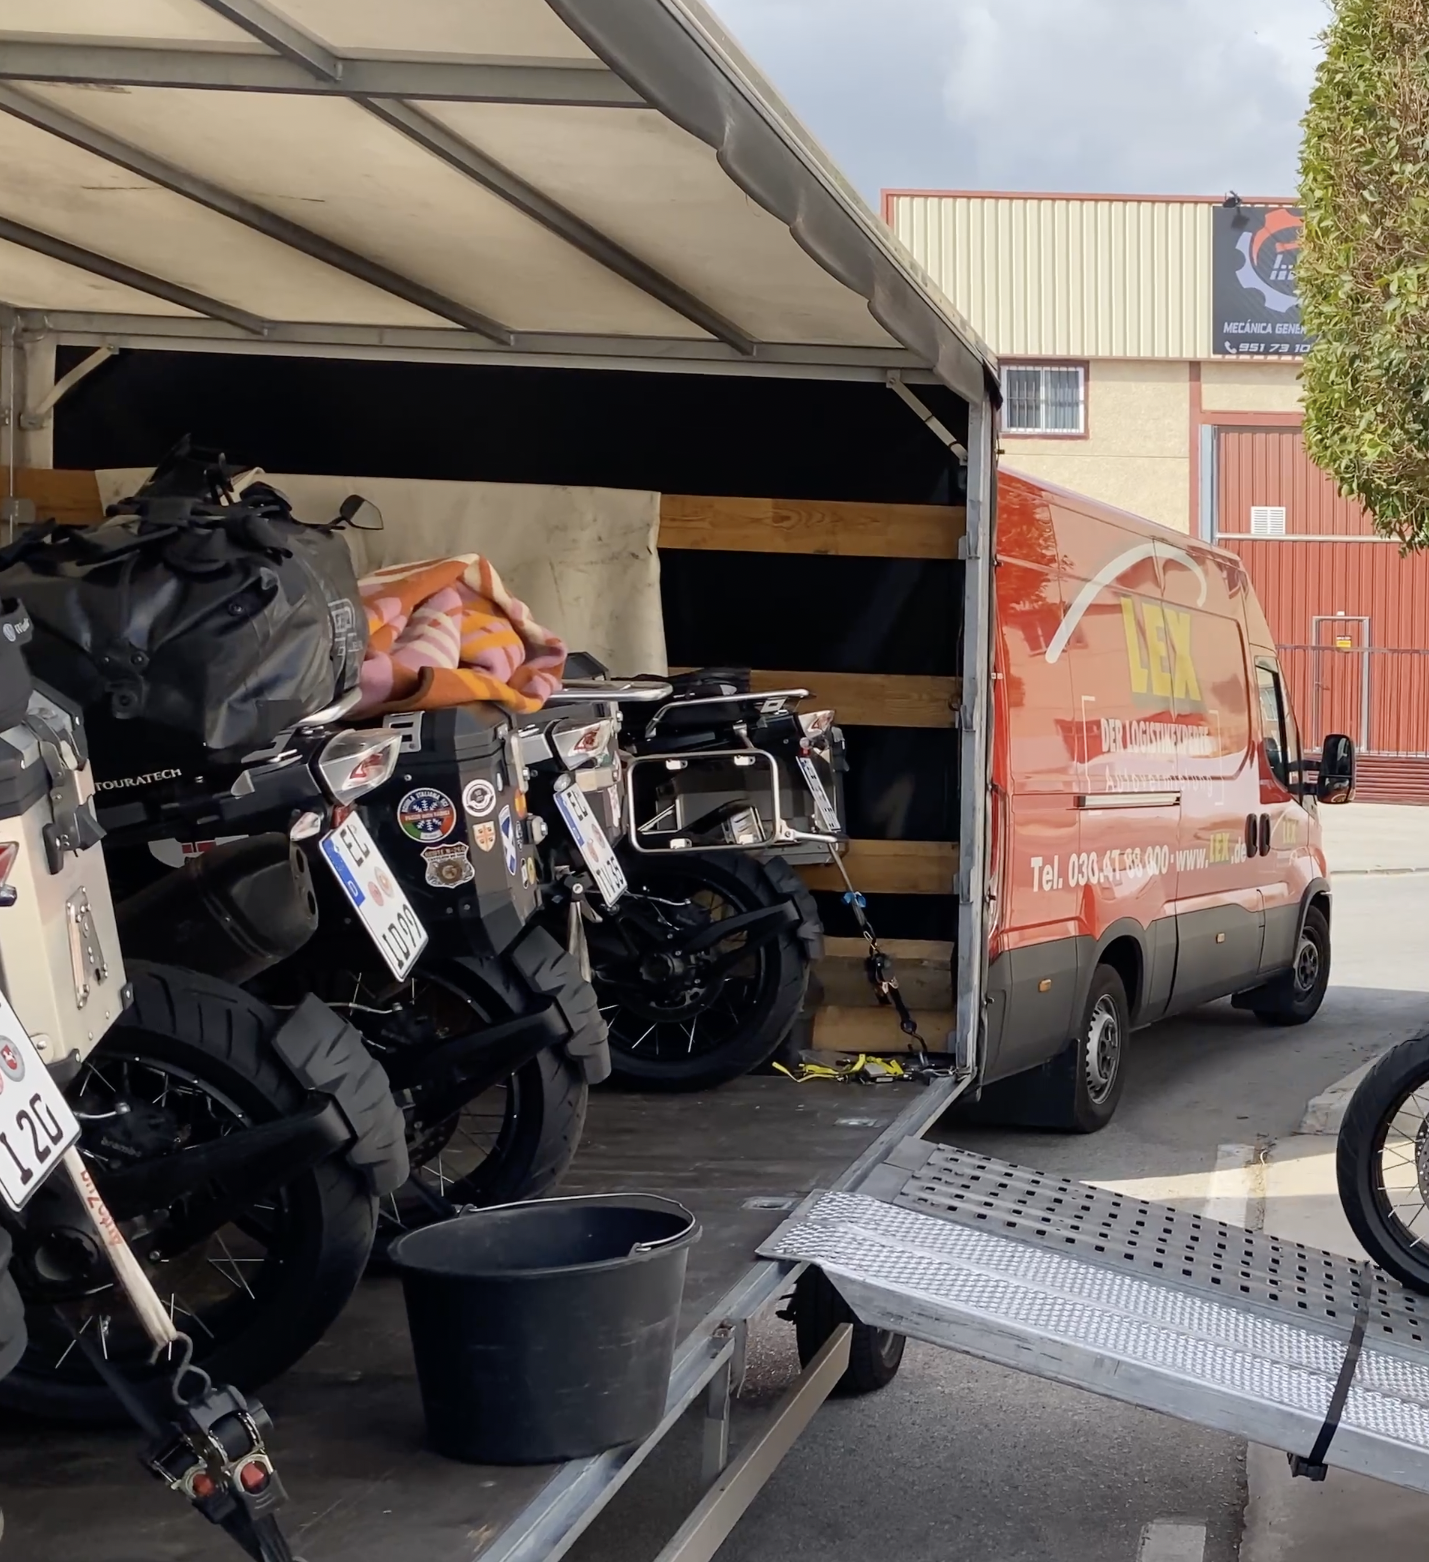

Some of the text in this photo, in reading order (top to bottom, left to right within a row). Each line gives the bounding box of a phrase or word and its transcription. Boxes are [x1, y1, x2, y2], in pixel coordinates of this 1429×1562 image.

[1223, 319, 1273, 335] MECÁNICA
[1239, 343, 1265, 353] 951
[1269, 343, 1290, 353] 73
[1120, 596, 1202, 702] LEX
[1100, 717, 1123, 753] DER
[95, 767, 183, 792] TOURATECH
[566, 789, 589, 822] EL
[339, 823, 372, 868] EL
[1030, 854, 1064, 893] Tel.
[15, 1092, 65, 1165] 20
